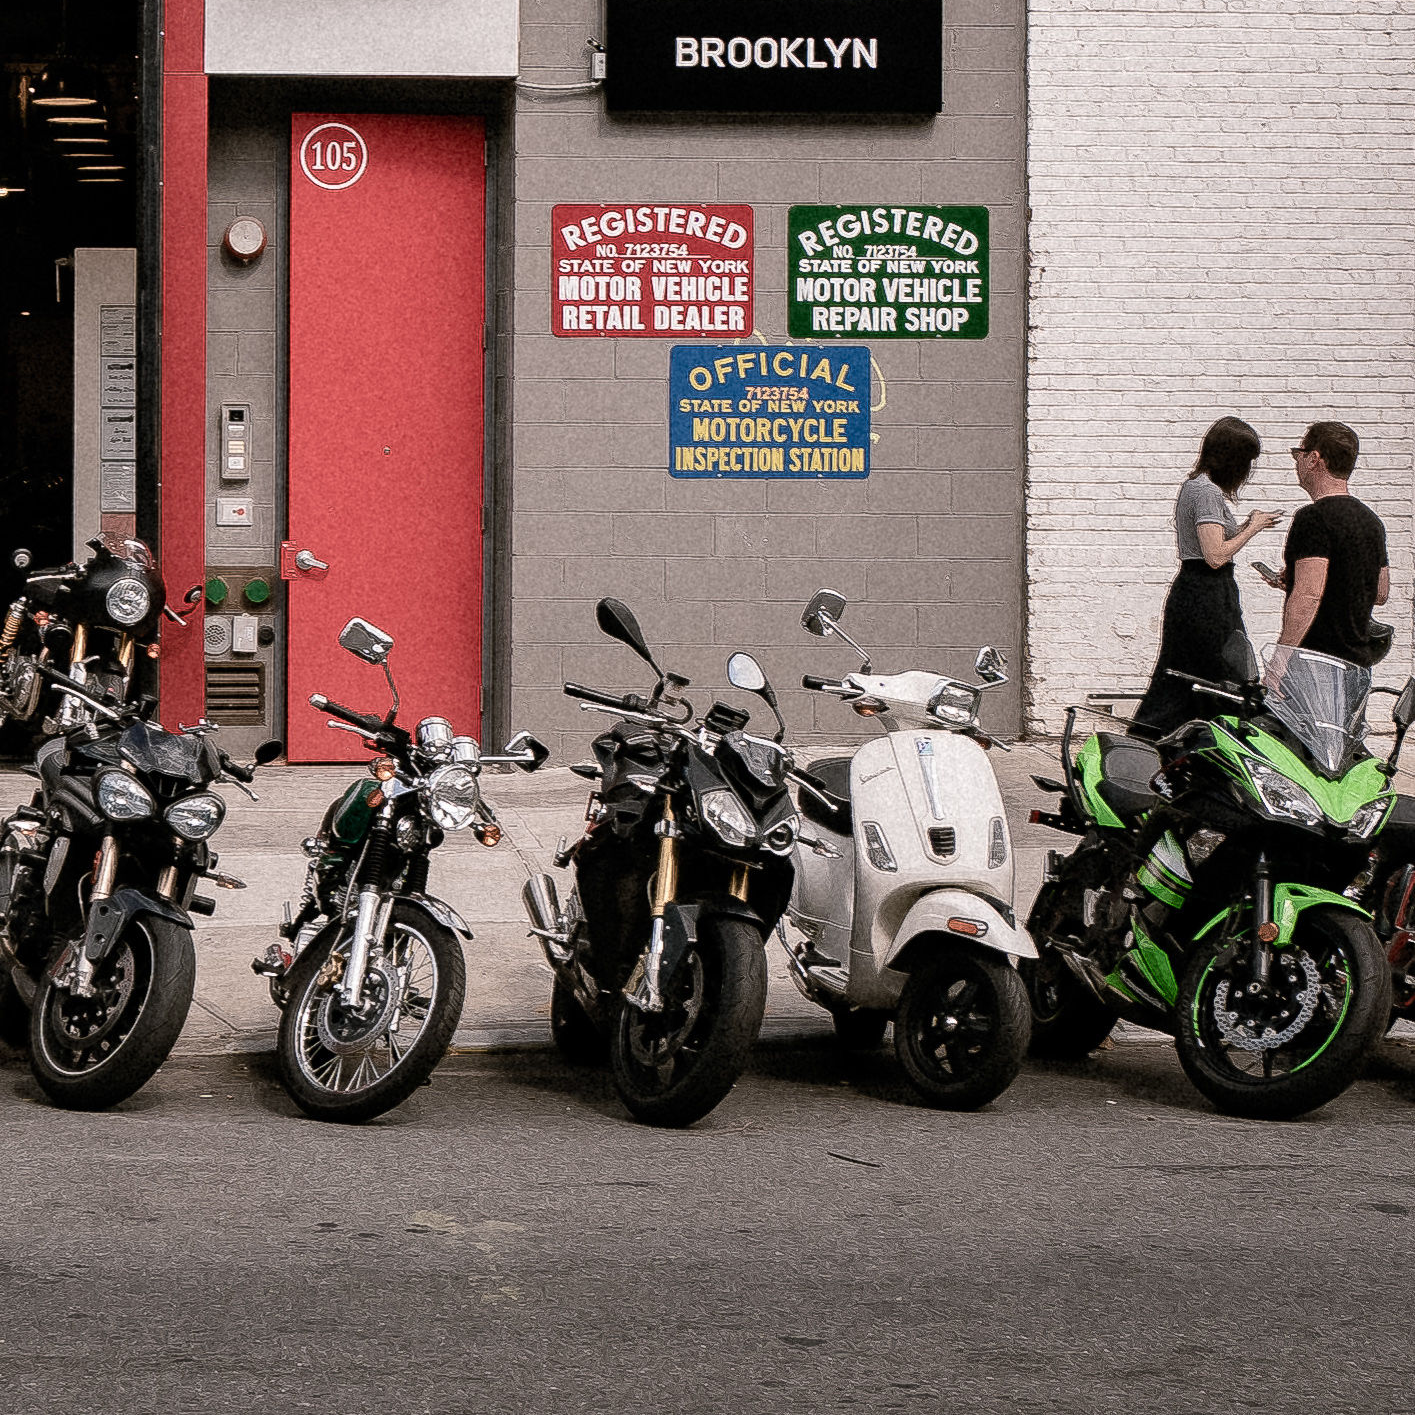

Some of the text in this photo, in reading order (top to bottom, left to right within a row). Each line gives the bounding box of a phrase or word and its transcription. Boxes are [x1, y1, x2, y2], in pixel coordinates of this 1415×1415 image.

[675, 37, 878, 69] BROOKLYN
[311, 141, 357, 171] 105
[561, 207, 748, 251] REGISTERED
[798, 207, 979, 256] REGISTERED
[625, 244, 688, 256] 7123754
[864, 245, 917, 258] 7123754
[559, 260, 749, 273] STATE OF NEW YORK
[799, 260, 980, 273] STATE OF NEW YORK
[559, 276, 748, 302] MOTOR VEHICLE
[797, 278, 982, 303] MOTOR VEHICLE
[563, 306, 745, 331] RETAIL DEALER
[813, 307, 969, 332] REPAIR SHOP
[689, 352, 856, 392] OFFICIAL
[680, 400, 859, 412] STATE OF NEW YORK
[745, 387, 809, 400] 7123754
[694, 418, 847, 443] MOTORCYCLE
[676, 447, 863, 472] INSPECTION STATION
